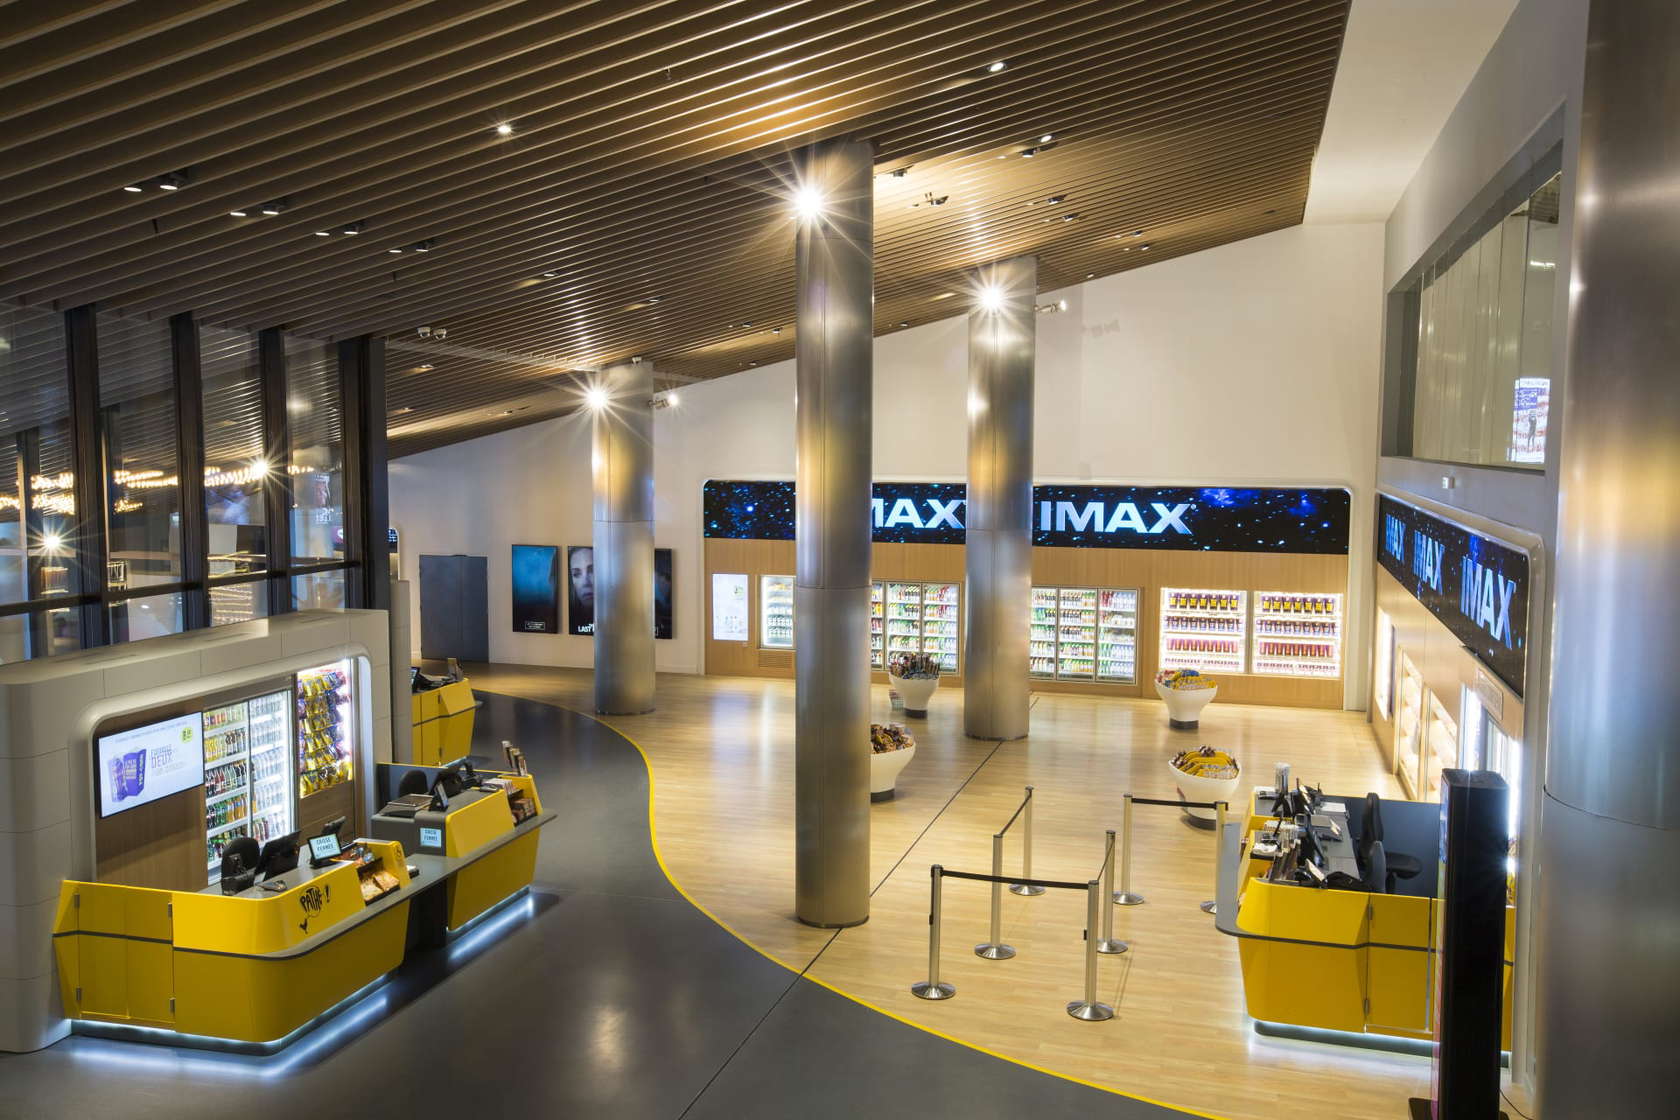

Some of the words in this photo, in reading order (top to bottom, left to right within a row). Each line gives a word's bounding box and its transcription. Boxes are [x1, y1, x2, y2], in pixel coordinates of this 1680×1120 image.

[1040, 501, 1193, 535] IMAX
[1413, 529, 1446, 596] IMAX
[1460, 555, 1517, 650] IMAX
